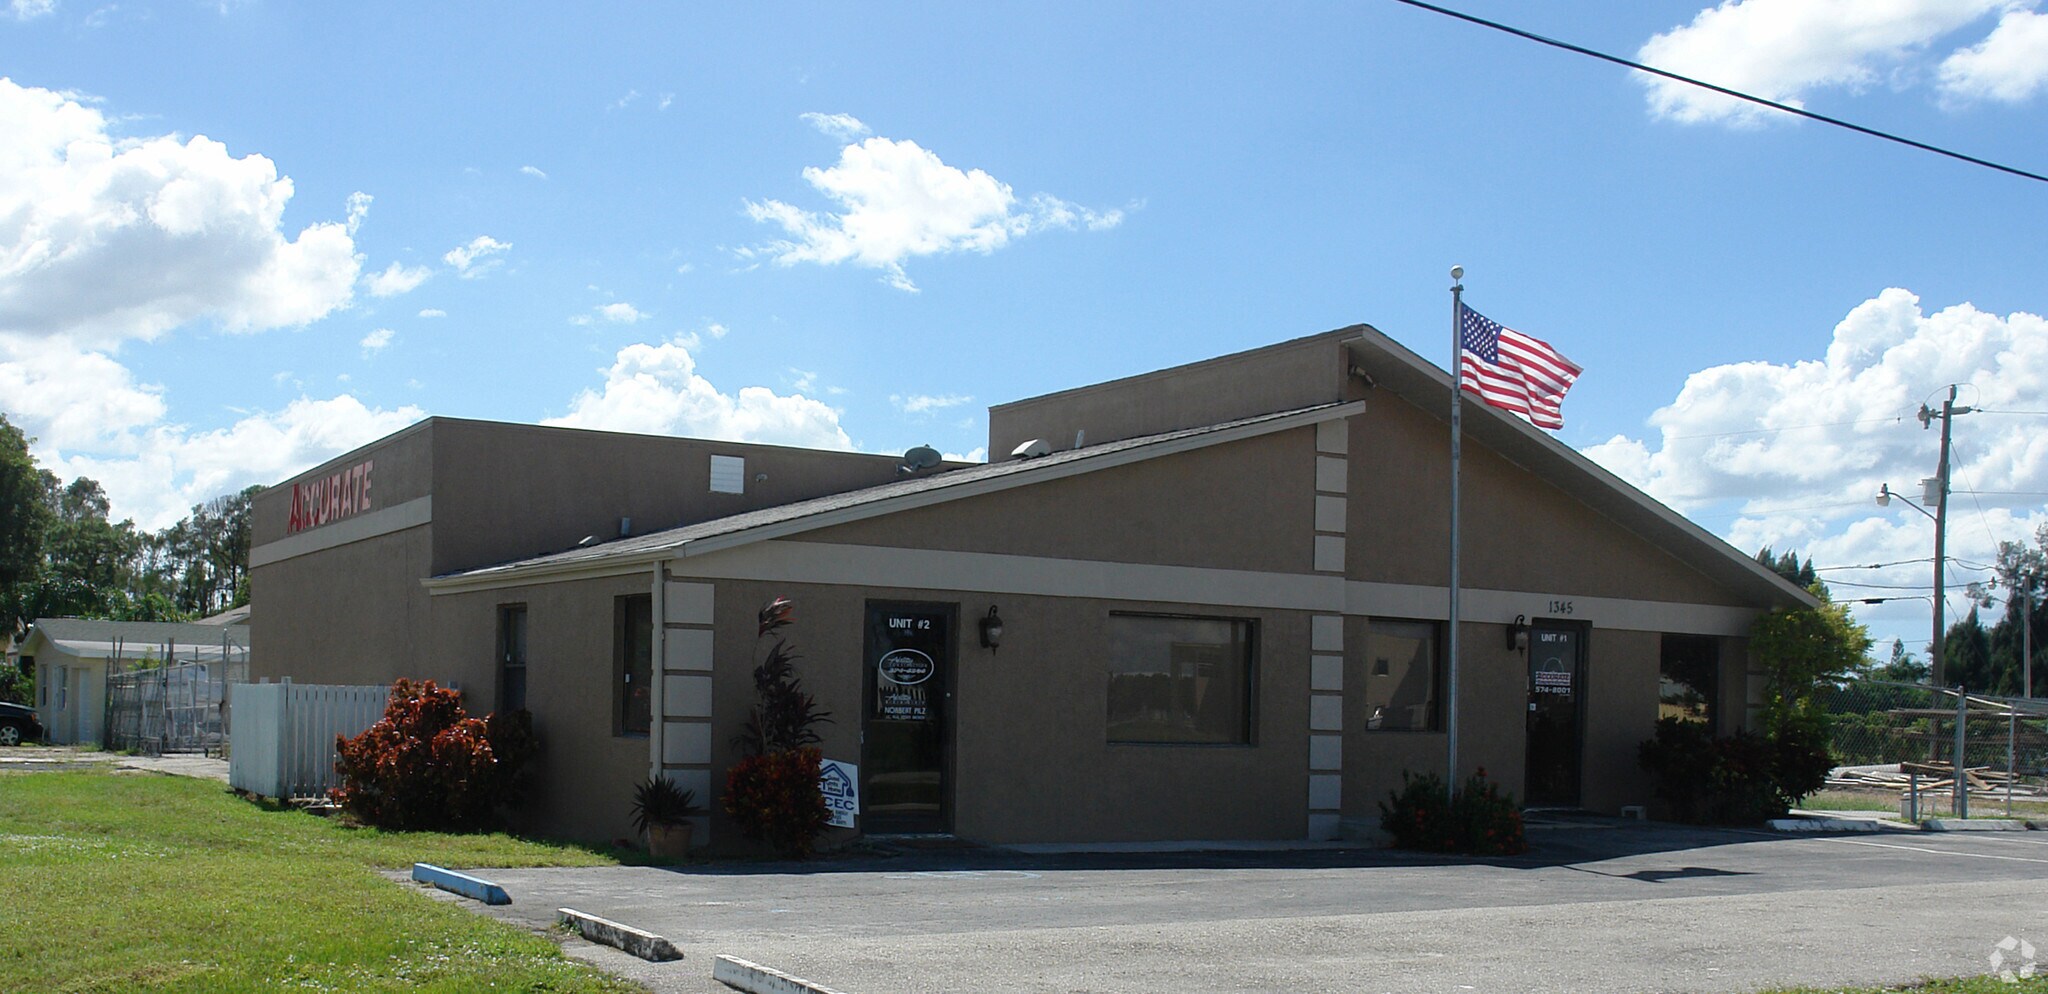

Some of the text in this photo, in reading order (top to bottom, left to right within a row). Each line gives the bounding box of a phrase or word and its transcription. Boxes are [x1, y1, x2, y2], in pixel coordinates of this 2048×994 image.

[288, 460, 374, 534] ACCURATE
[1549, 600, 1573, 614] 1345
[889, 618, 930, 629] UNIT #2
[1541, 633, 1568, 642] UNIT #1
